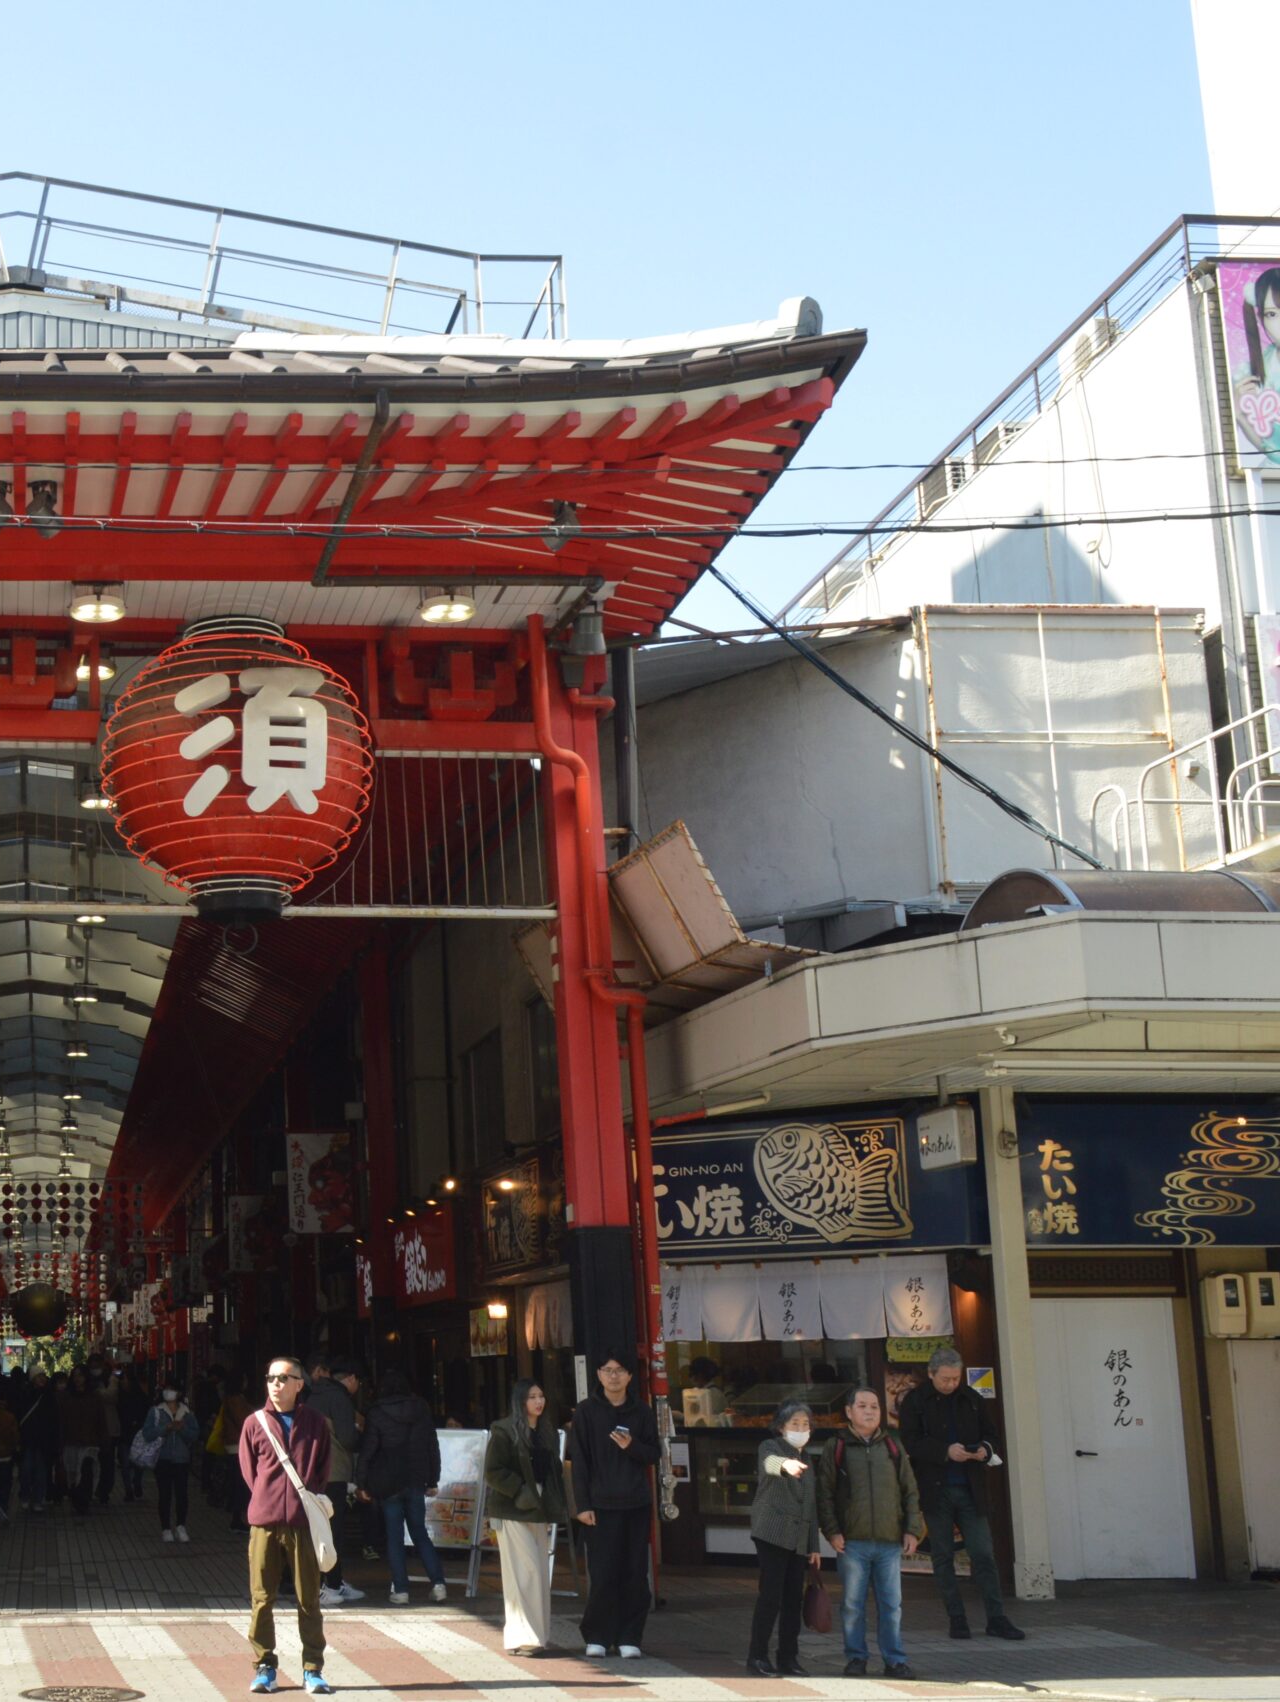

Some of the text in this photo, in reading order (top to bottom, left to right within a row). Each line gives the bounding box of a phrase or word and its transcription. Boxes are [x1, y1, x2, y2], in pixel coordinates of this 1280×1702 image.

[173, 665, 329, 817] 須
[668, 1162, 744, 1178] GIN-NO AN
[1037, 1138, 1080, 1235] たい焼
[778, 1282, 798, 1336] 銀のあん
[905, 1276, 926, 1332] 銀のあん
[1104, 1349, 1133, 1427] 銀のあん
